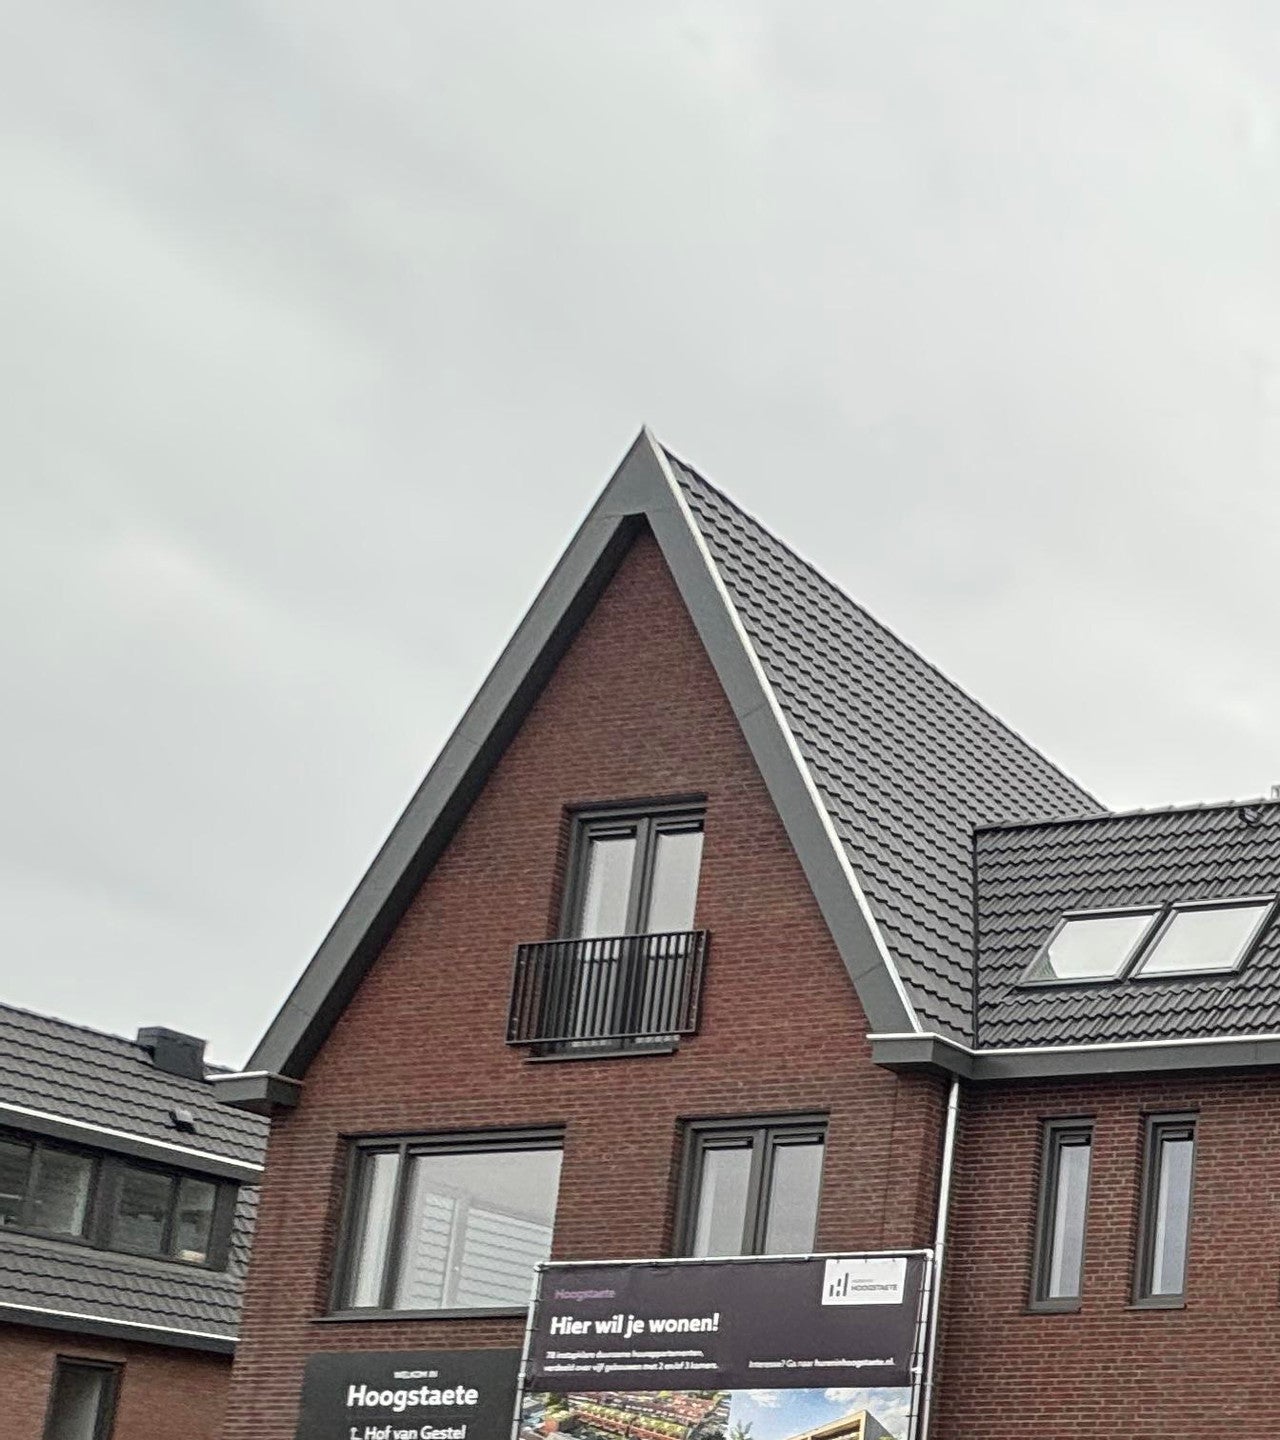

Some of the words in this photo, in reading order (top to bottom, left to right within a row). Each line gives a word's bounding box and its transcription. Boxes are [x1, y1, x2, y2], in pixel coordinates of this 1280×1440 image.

[550, 1316, 591, 1335] Hier
[594, 1314, 624, 1334] wil
[623, 1314, 645, 1339] je
[649, 1312, 720, 1333] wonen!
[658, 1361, 664, 1370] 2
[346, 1384, 479, 1412] Hoogstaete
[364, 1425, 392, 1440] Hof
[393, 1429, 418, 1440] van
[420, 1424, 467, 1440] Gestel
